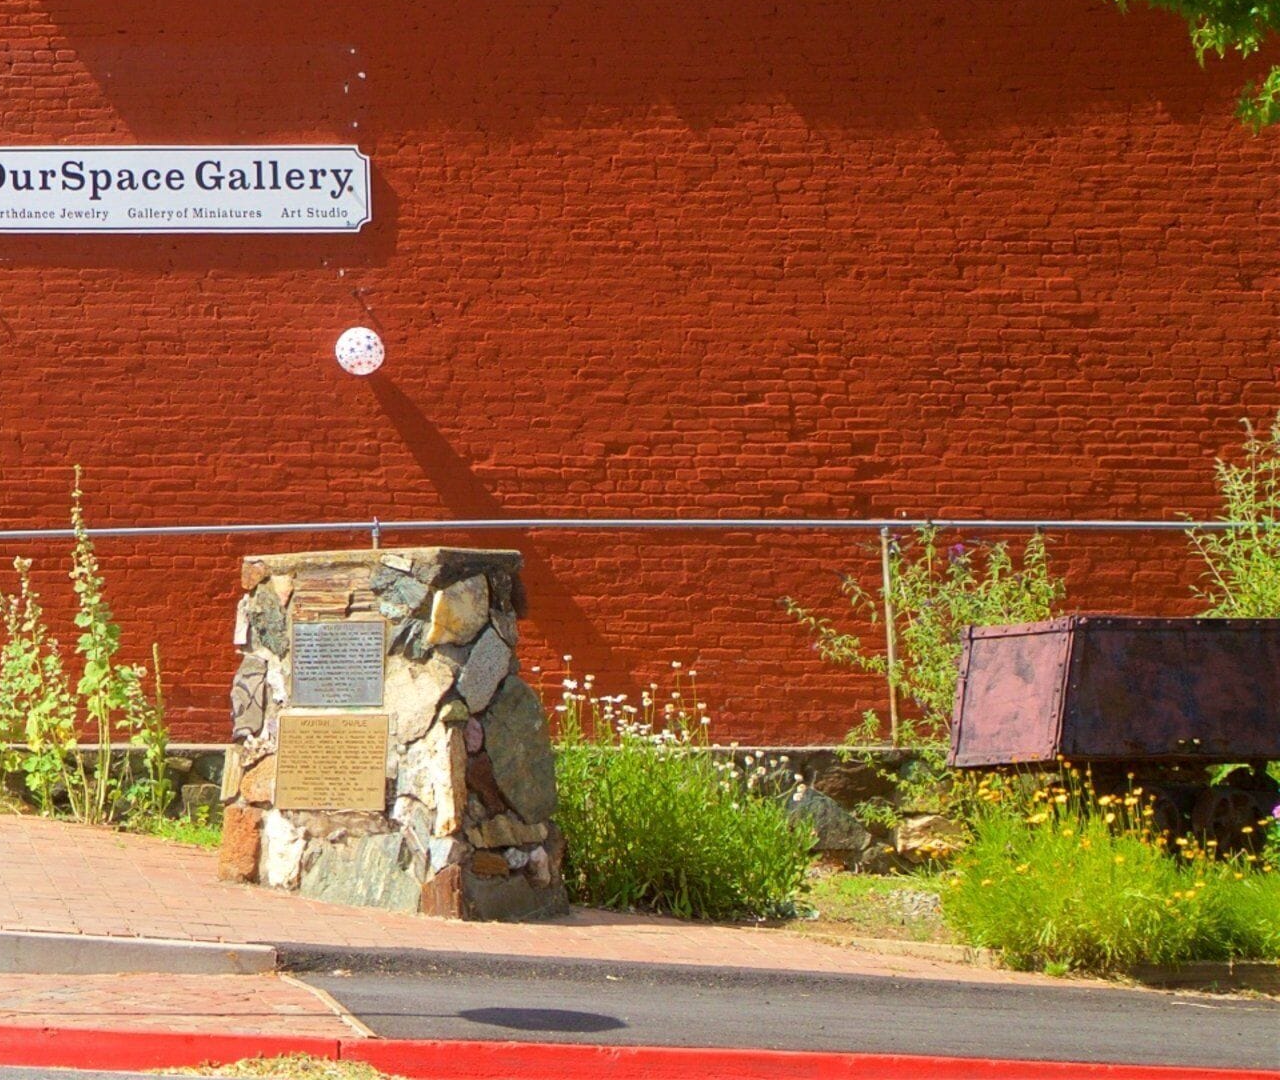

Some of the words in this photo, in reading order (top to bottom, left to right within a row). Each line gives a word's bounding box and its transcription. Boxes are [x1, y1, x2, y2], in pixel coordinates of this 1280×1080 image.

[195, 160, 353, 199] Gallery
[60, 208, 109, 221] Jewelry
[127, 207, 174, 221] Gallery
[176, 207, 188, 219] of
[192, 207, 262, 219] Miniatures
[281, 207, 301, 219] Art
[307, 207, 348, 219] Studio
